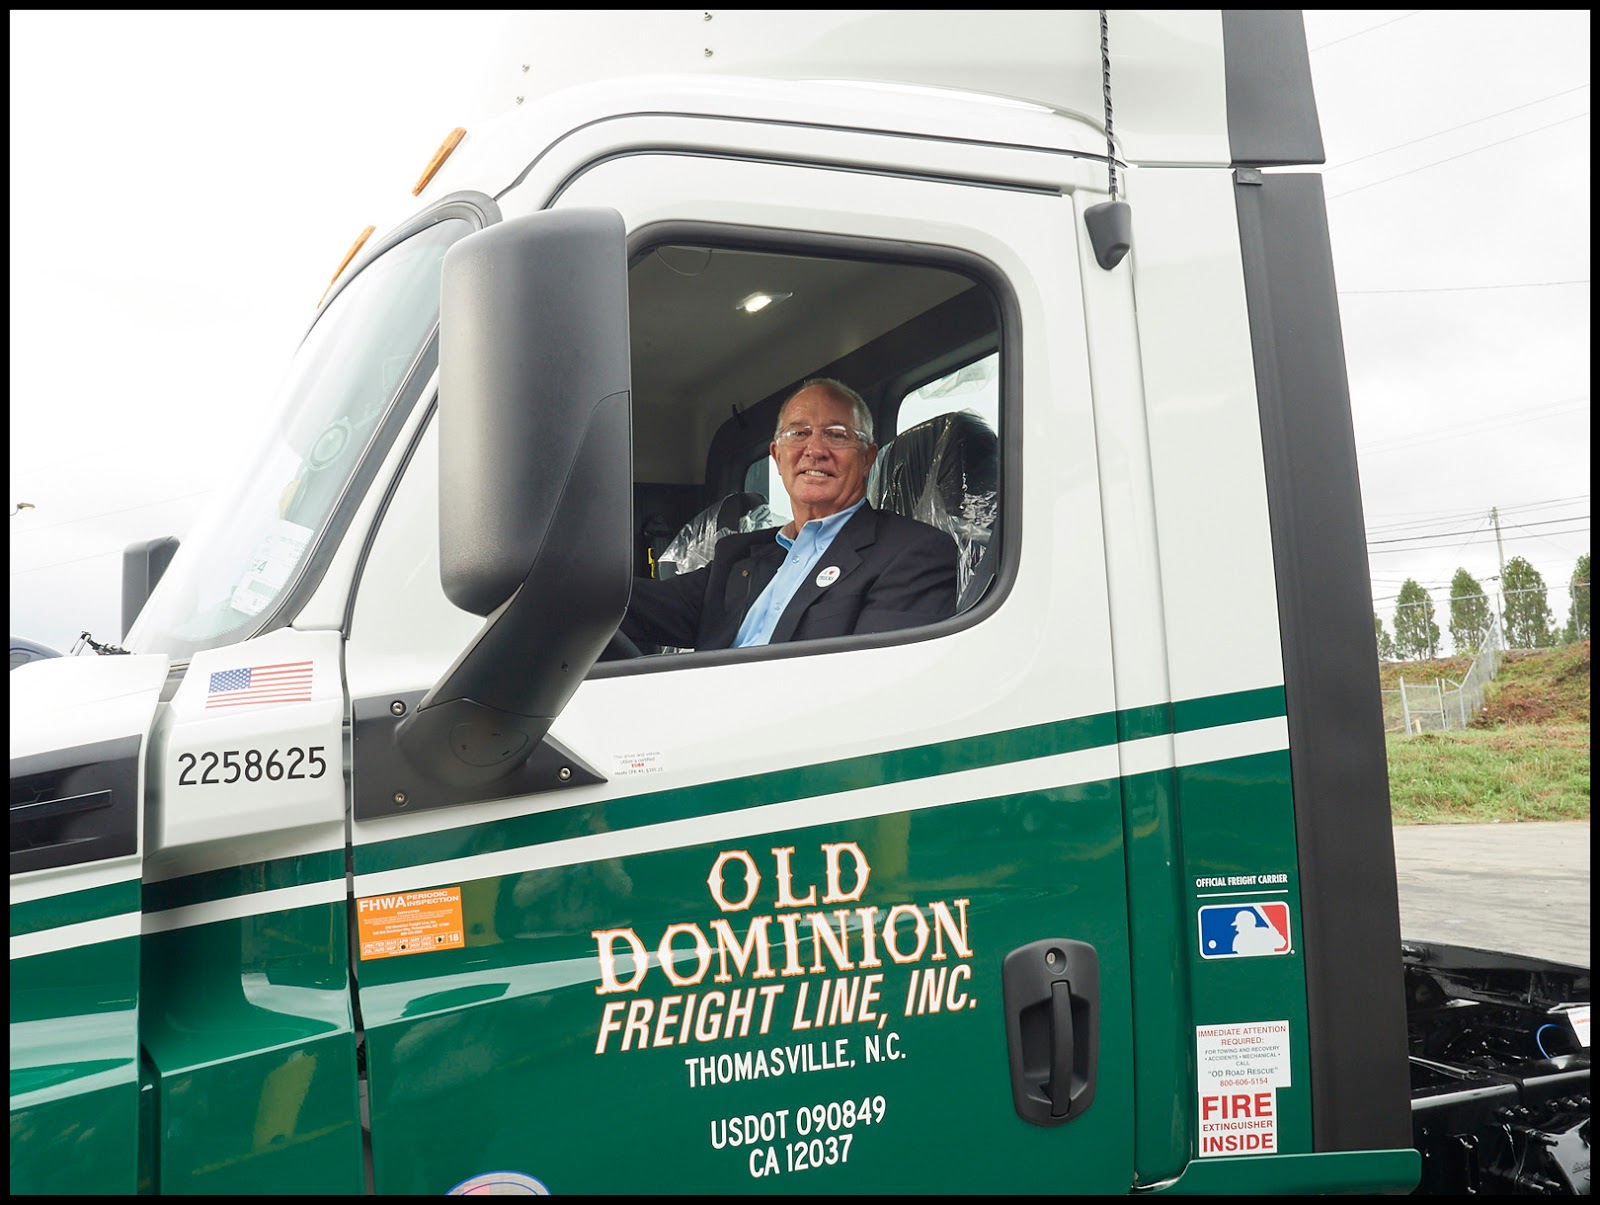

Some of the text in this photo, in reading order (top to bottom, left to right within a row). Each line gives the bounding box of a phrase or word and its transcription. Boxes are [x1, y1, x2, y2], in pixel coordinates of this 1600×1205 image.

[178, 746, 326, 785] 2258625
[707, 842, 871, 912] OLD
[1195, 873, 1288, 888] OFFICIAL FREIGHT CARRIER
[359, 896, 407, 912] FHWA
[406, 891, 448, 901] PERIODIC
[406, 895, 459, 907] INSPECTION
[449, 933, 459, 941] 18
[591, 899, 973, 994] DOMINION
[595, 963, 977, 1054] FREIGHT LINE, INC.
[1198, 1025, 1286, 1038] IMMEDIATE ATTENTION
[1221, 1036, 1264, 1046] REQUIRED:
[685, 1032, 906, 1087] THOMASVILLE, N.C.
[1219, 1077, 1268, 1087] 800-606-5154
[1202, 1092, 1273, 1120] FIRE
[711, 1095, 886, 1149] USDOT 090849
[1202, 1119, 1273, 1132] EXTINGUISHER
[1203, 1133, 1274, 1153] INSIDE
[749, 1134, 853, 1178] CA 12037
